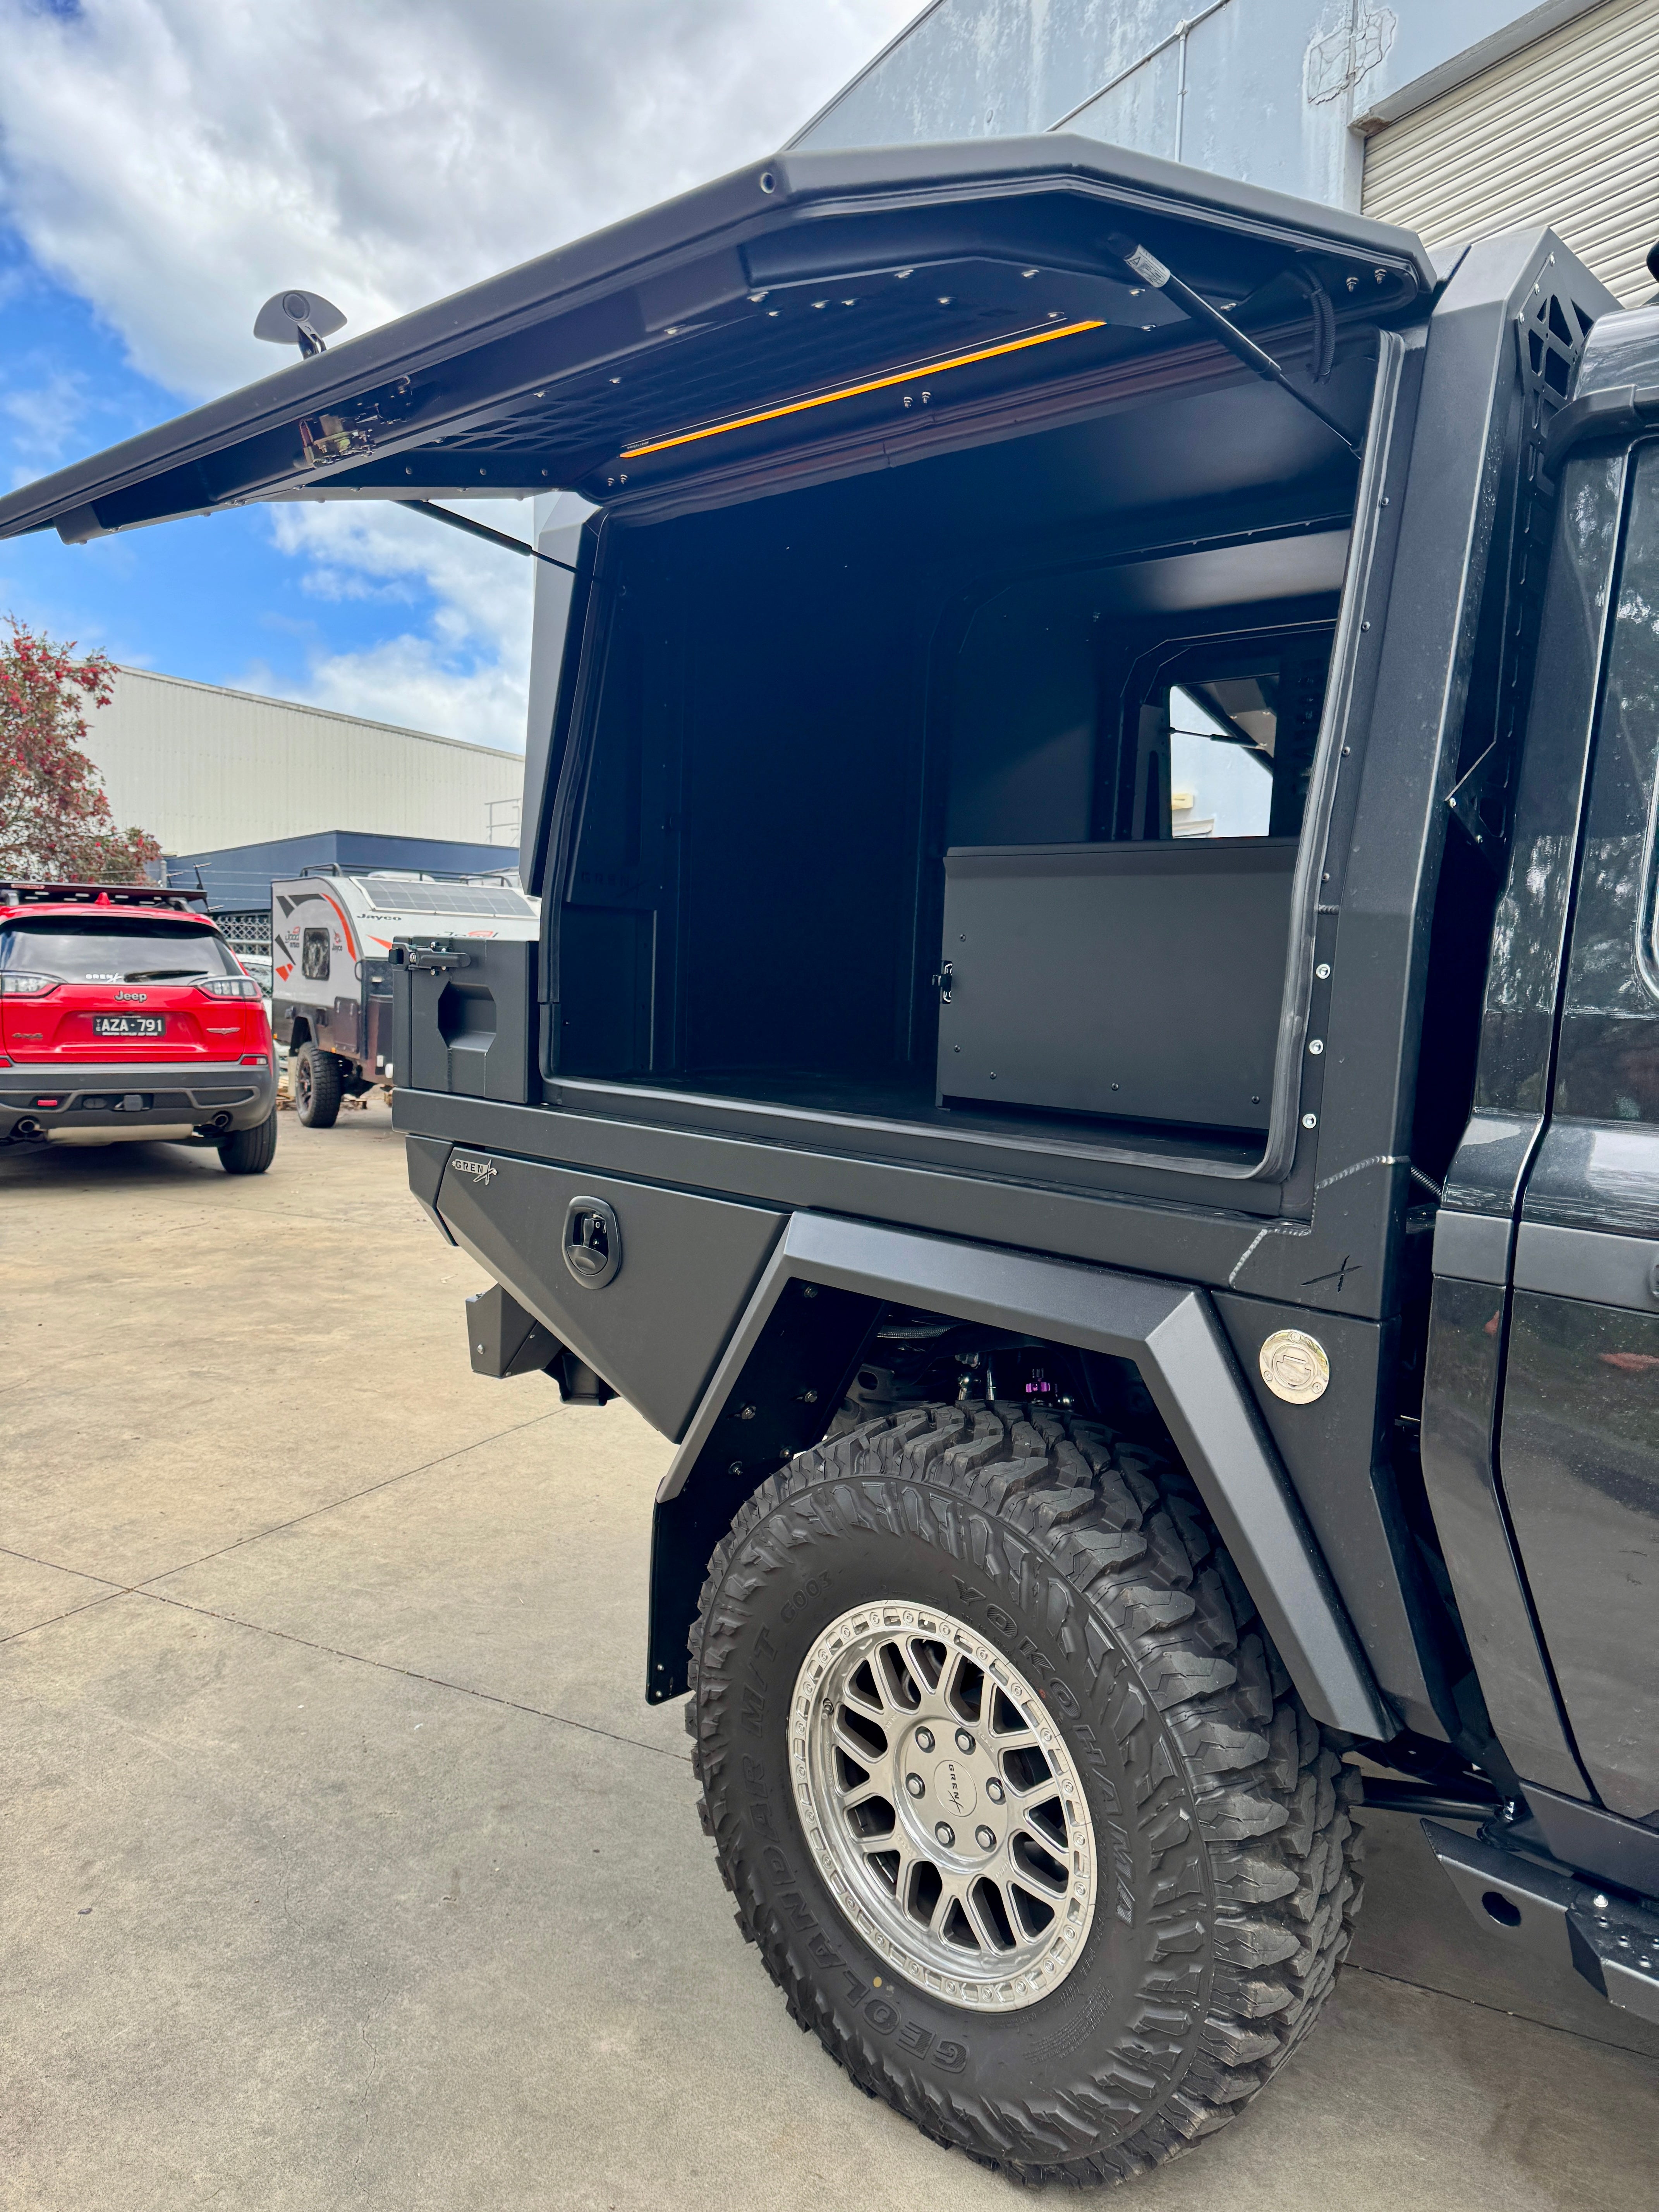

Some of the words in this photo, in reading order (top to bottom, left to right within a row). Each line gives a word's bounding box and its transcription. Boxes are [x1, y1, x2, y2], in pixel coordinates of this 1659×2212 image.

[114, 990, 147, 1003] Jeep
[780, 1570, 833, 1625] G003
[741, 1622, 778, 1738] M/T
[952, 1575, 1135, 1929] YOKOHAMA
[742, 1753, 970, 2073] GEOLANDAR
